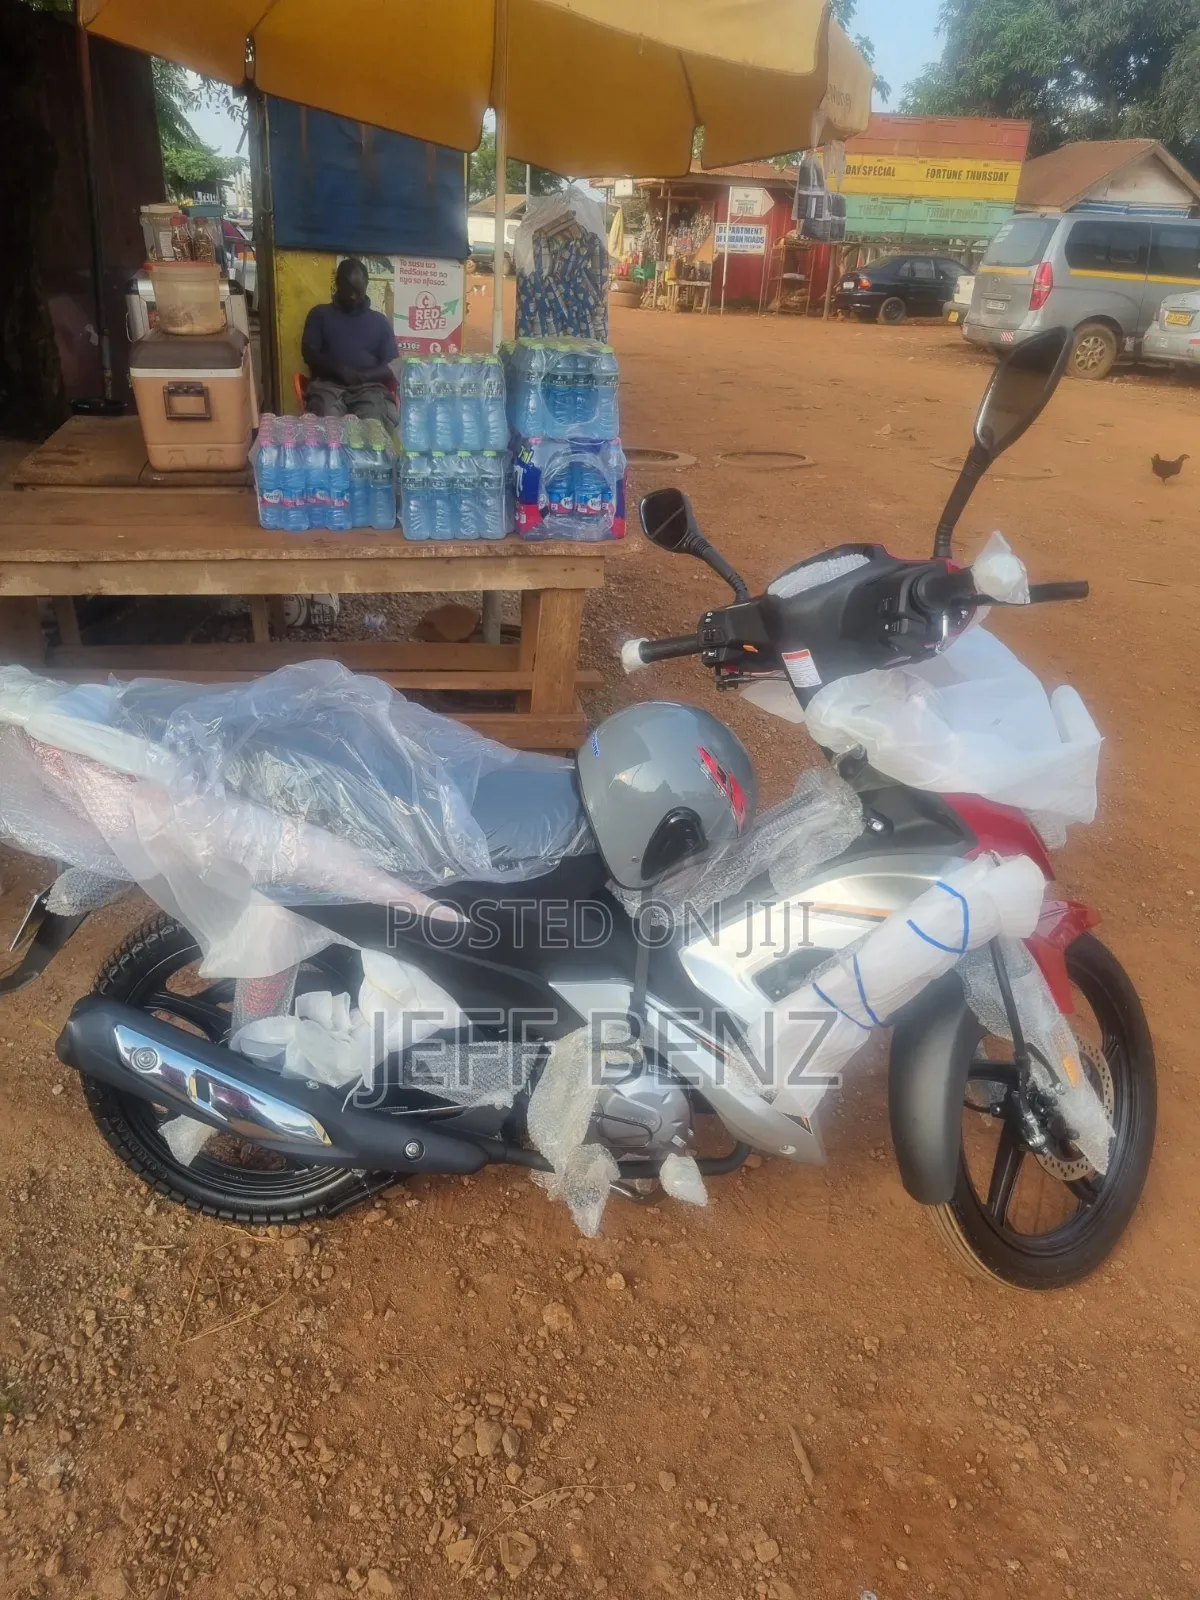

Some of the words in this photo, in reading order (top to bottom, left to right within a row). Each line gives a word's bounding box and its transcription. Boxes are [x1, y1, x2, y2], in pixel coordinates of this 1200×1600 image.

[862, 165, 895, 177] SPECIAL
[926, 168, 963, 181] FORTUNE
[966, 170, 1009, 182] THURSDAY
[718, 226, 763, 235] DEPARTMENT
[716, 235, 723, 243] OF
[723, 235, 744, 243] URBAN
[744, 236, 765, 244] ROADS
[408, 260, 424, 268] susu
[400, 267, 428, 277] RedSave
[415, 309, 440, 320] RED
[414, 318, 447, 330] SAVE
